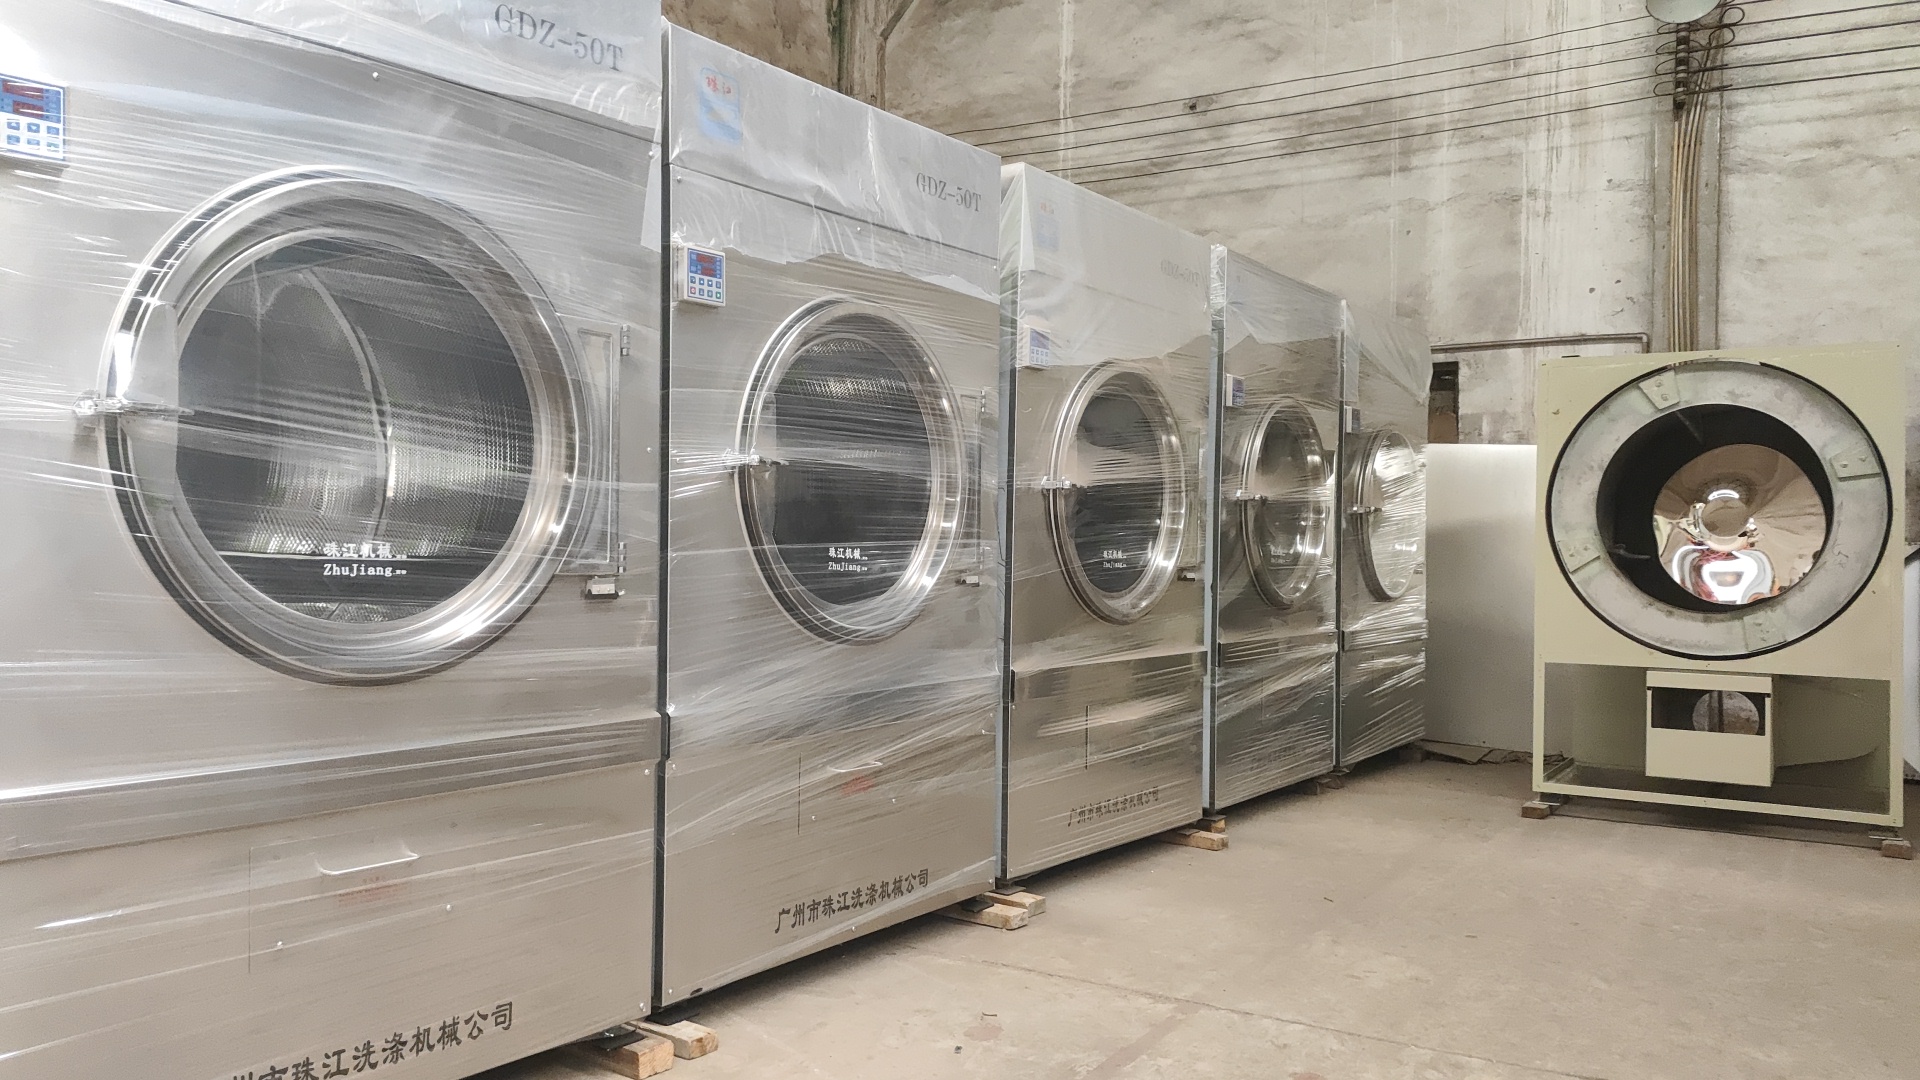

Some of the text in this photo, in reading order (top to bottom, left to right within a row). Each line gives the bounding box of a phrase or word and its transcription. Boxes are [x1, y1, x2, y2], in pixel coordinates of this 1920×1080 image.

[494, 3, 623, 72] GDZ-50T
[916, 172, 982, 212] GDZ-50T
[323, 542, 393, 559] 珠江机械
[828, 546, 861, 560] 珠江机械
[323, 563, 393, 577] ZhuJiang
[828, 561, 861, 573] ZhuJiang
[774, 868, 929, 934] 广州市珠江洗涤机械公司
[232, 1001, 513, 1080] 珠江洗涤机械公司
